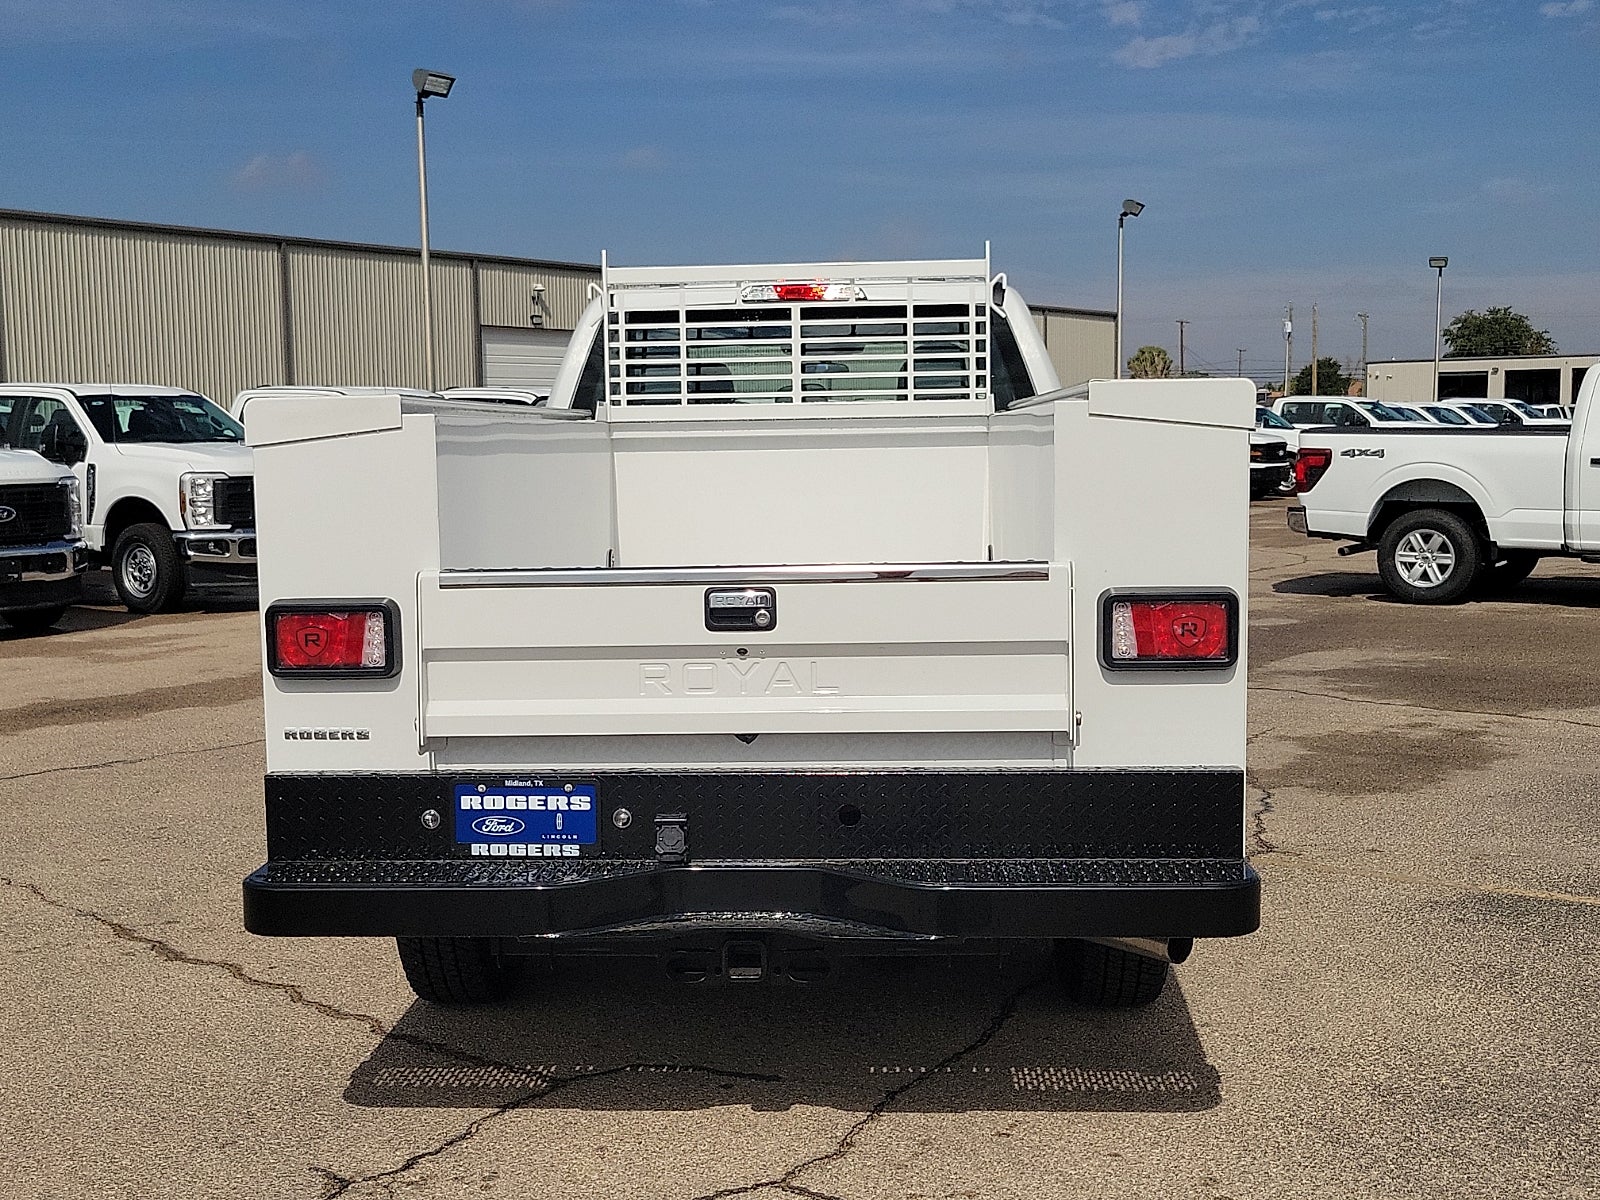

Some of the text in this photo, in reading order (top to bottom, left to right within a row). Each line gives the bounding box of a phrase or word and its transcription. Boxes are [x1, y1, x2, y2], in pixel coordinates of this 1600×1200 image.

[714, 596, 767, 606] ROYAL
[1180, 622, 1198, 638] R
[304, 633, 321, 648] R
[638, 661, 839, 695] ROYAL
[284, 729, 370, 741] ROGERS
[505, 780, 533, 788] Midland,
[460, 795, 591, 811] ROGERS
[481, 818, 515, 833] Ford
[471, 843, 580, 857] ROGERS
